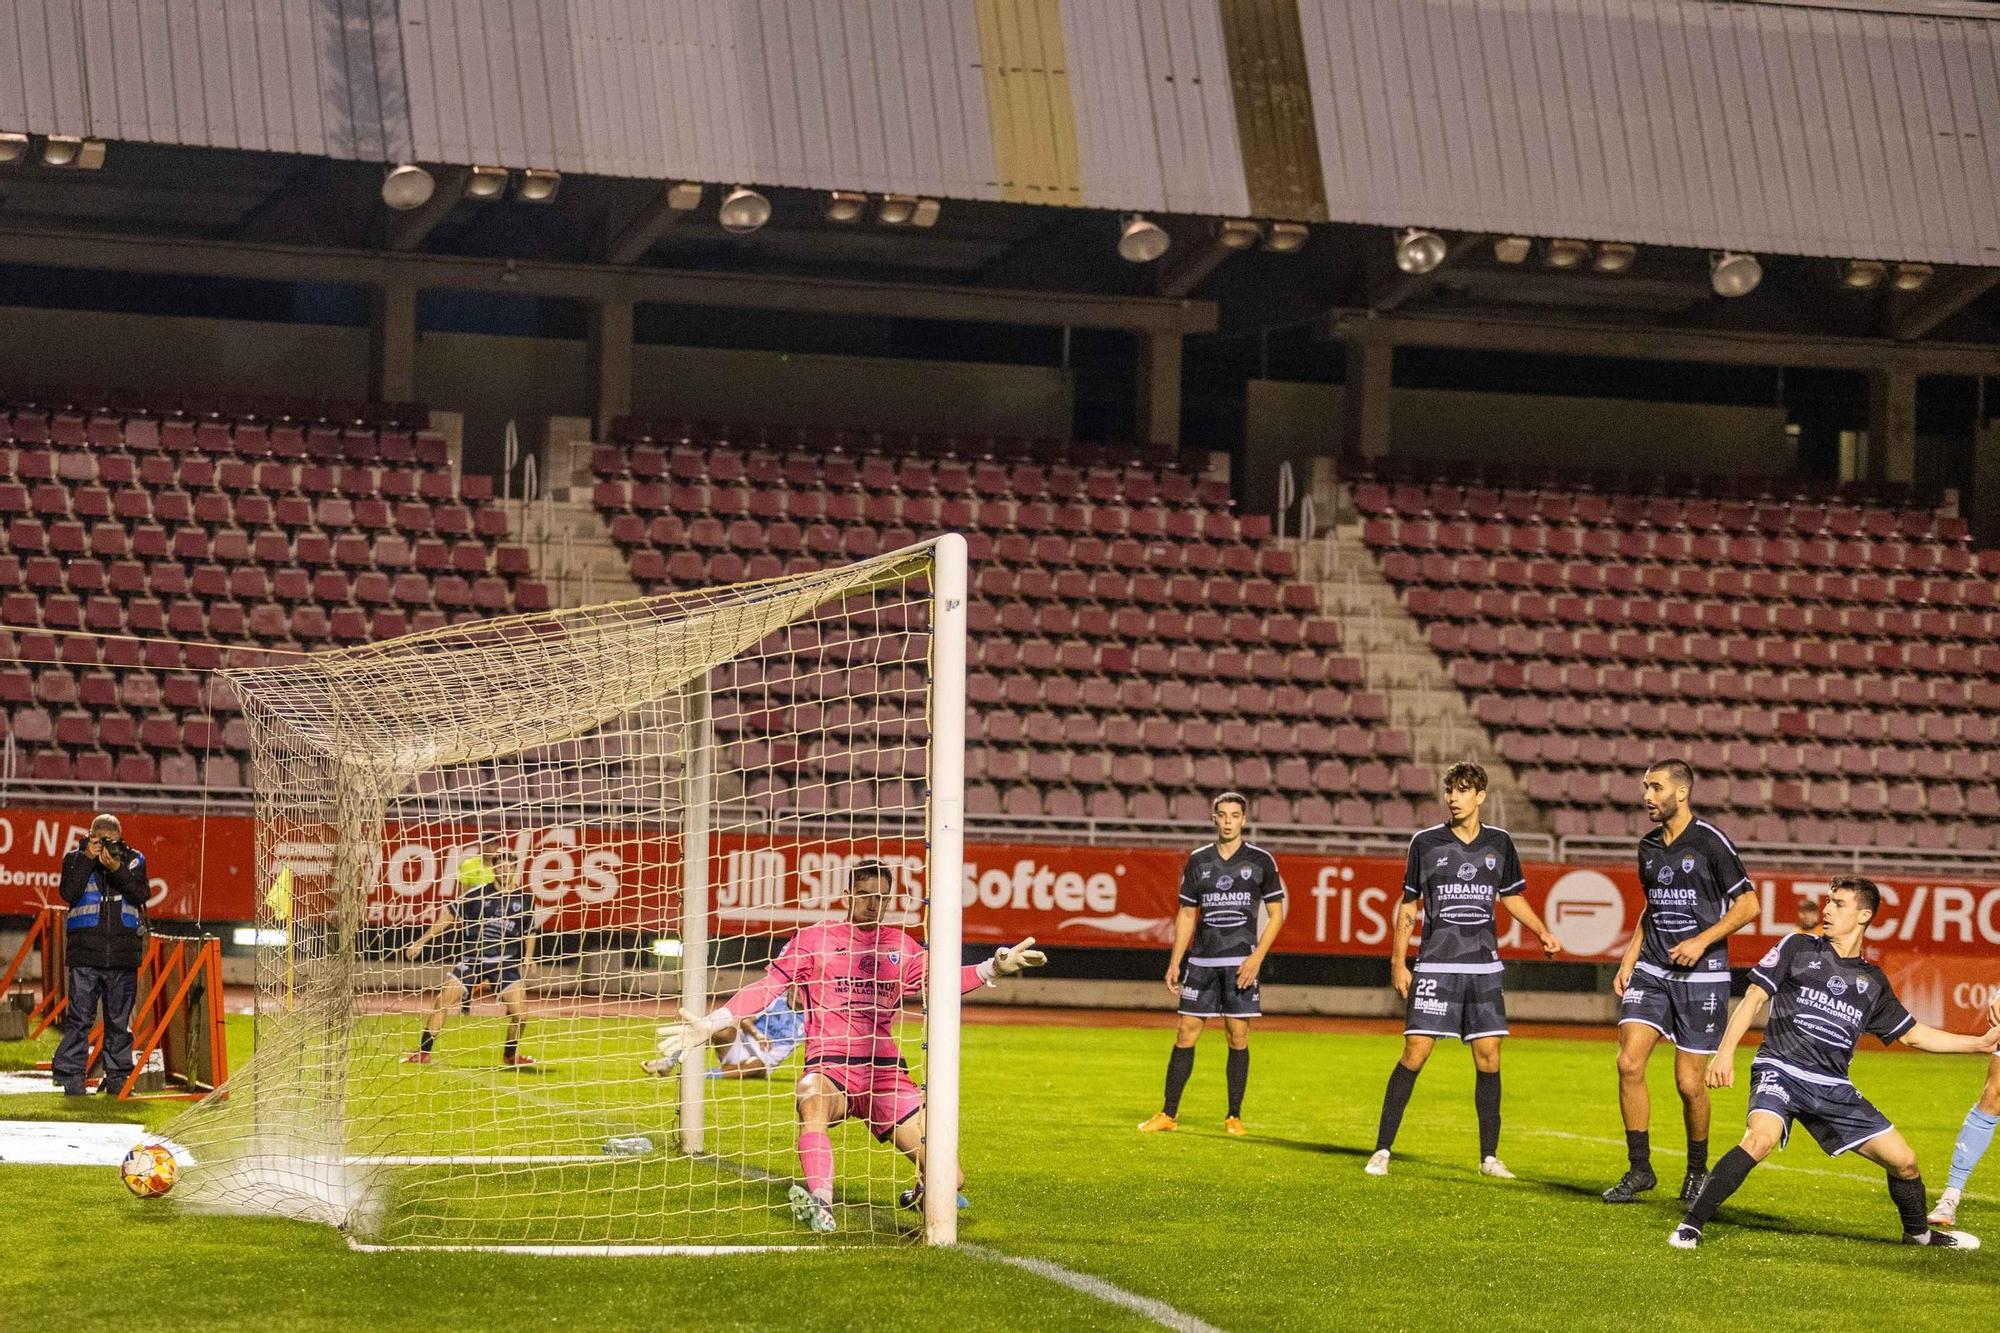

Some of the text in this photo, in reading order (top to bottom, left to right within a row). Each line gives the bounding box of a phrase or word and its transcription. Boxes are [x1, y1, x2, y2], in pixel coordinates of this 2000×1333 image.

[716, 849, 923, 912] JIM SPTS
[1201, 892, 1251, 902] TUBANOR
[1436, 884, 1494, 895] TUBANOR
[1648, 888, 1697, 899] TUBANOR
[1416, 978, 1438, 997] 22
[1414, 997, 1448, 1011] BigMat
[1796, 996, 1852, 1023] INSTALACIONES
[1799, 986, 1863, 1020] TUBANOR
[1793, 1017, 1853, 1046] integralmotion.es
[1760, 1070, 1779, 1084] 12
